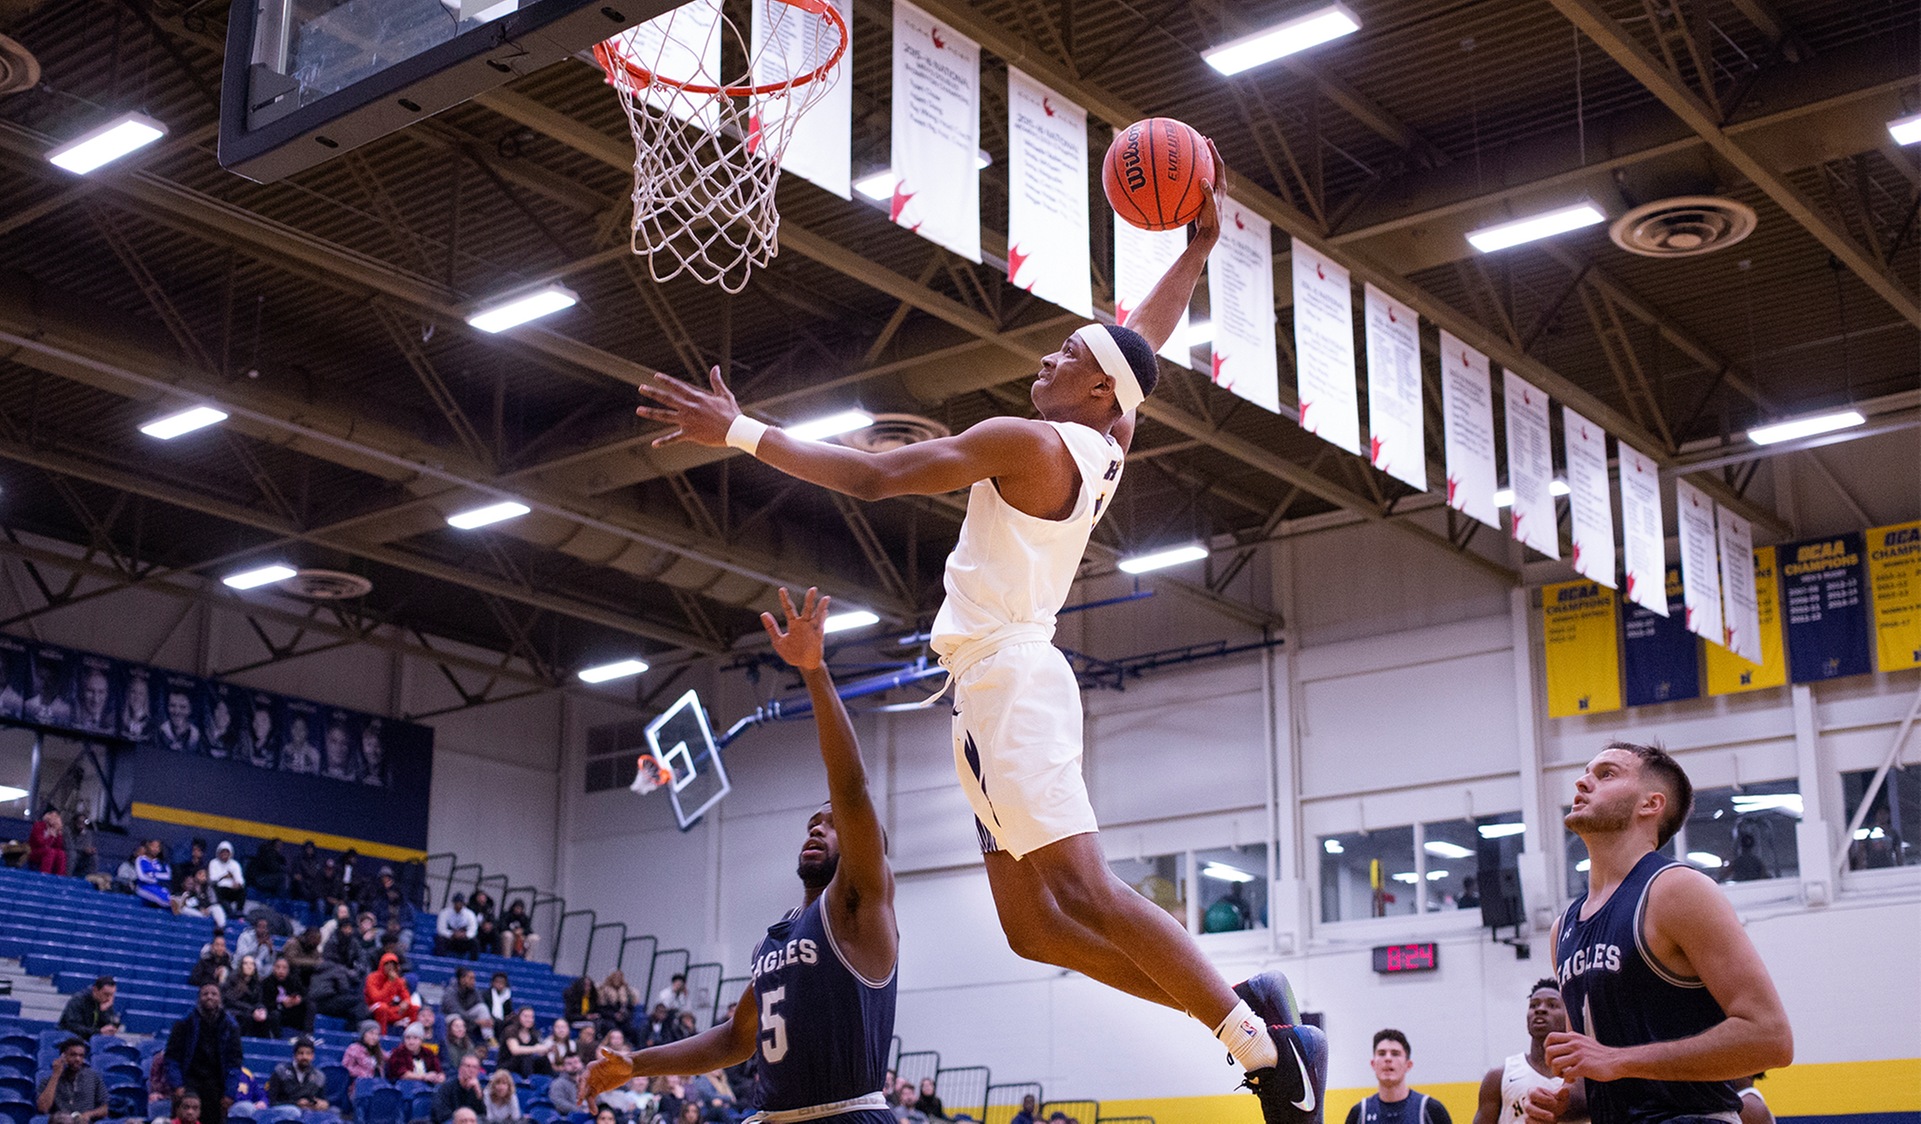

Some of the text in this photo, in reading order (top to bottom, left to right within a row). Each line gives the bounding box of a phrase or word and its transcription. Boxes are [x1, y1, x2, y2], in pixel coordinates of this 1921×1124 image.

[1122, 125, 1147, 193] Wilson
[1796, 540, 1846, 561] OCAA
[1784, 554, 1859, 577] CHAMPIONS
[1546, 597, 1611, 615] CHAMPIONS
[1387, 944, 1433, 971] 8:24
[761, 987, 788, 1063] 5
